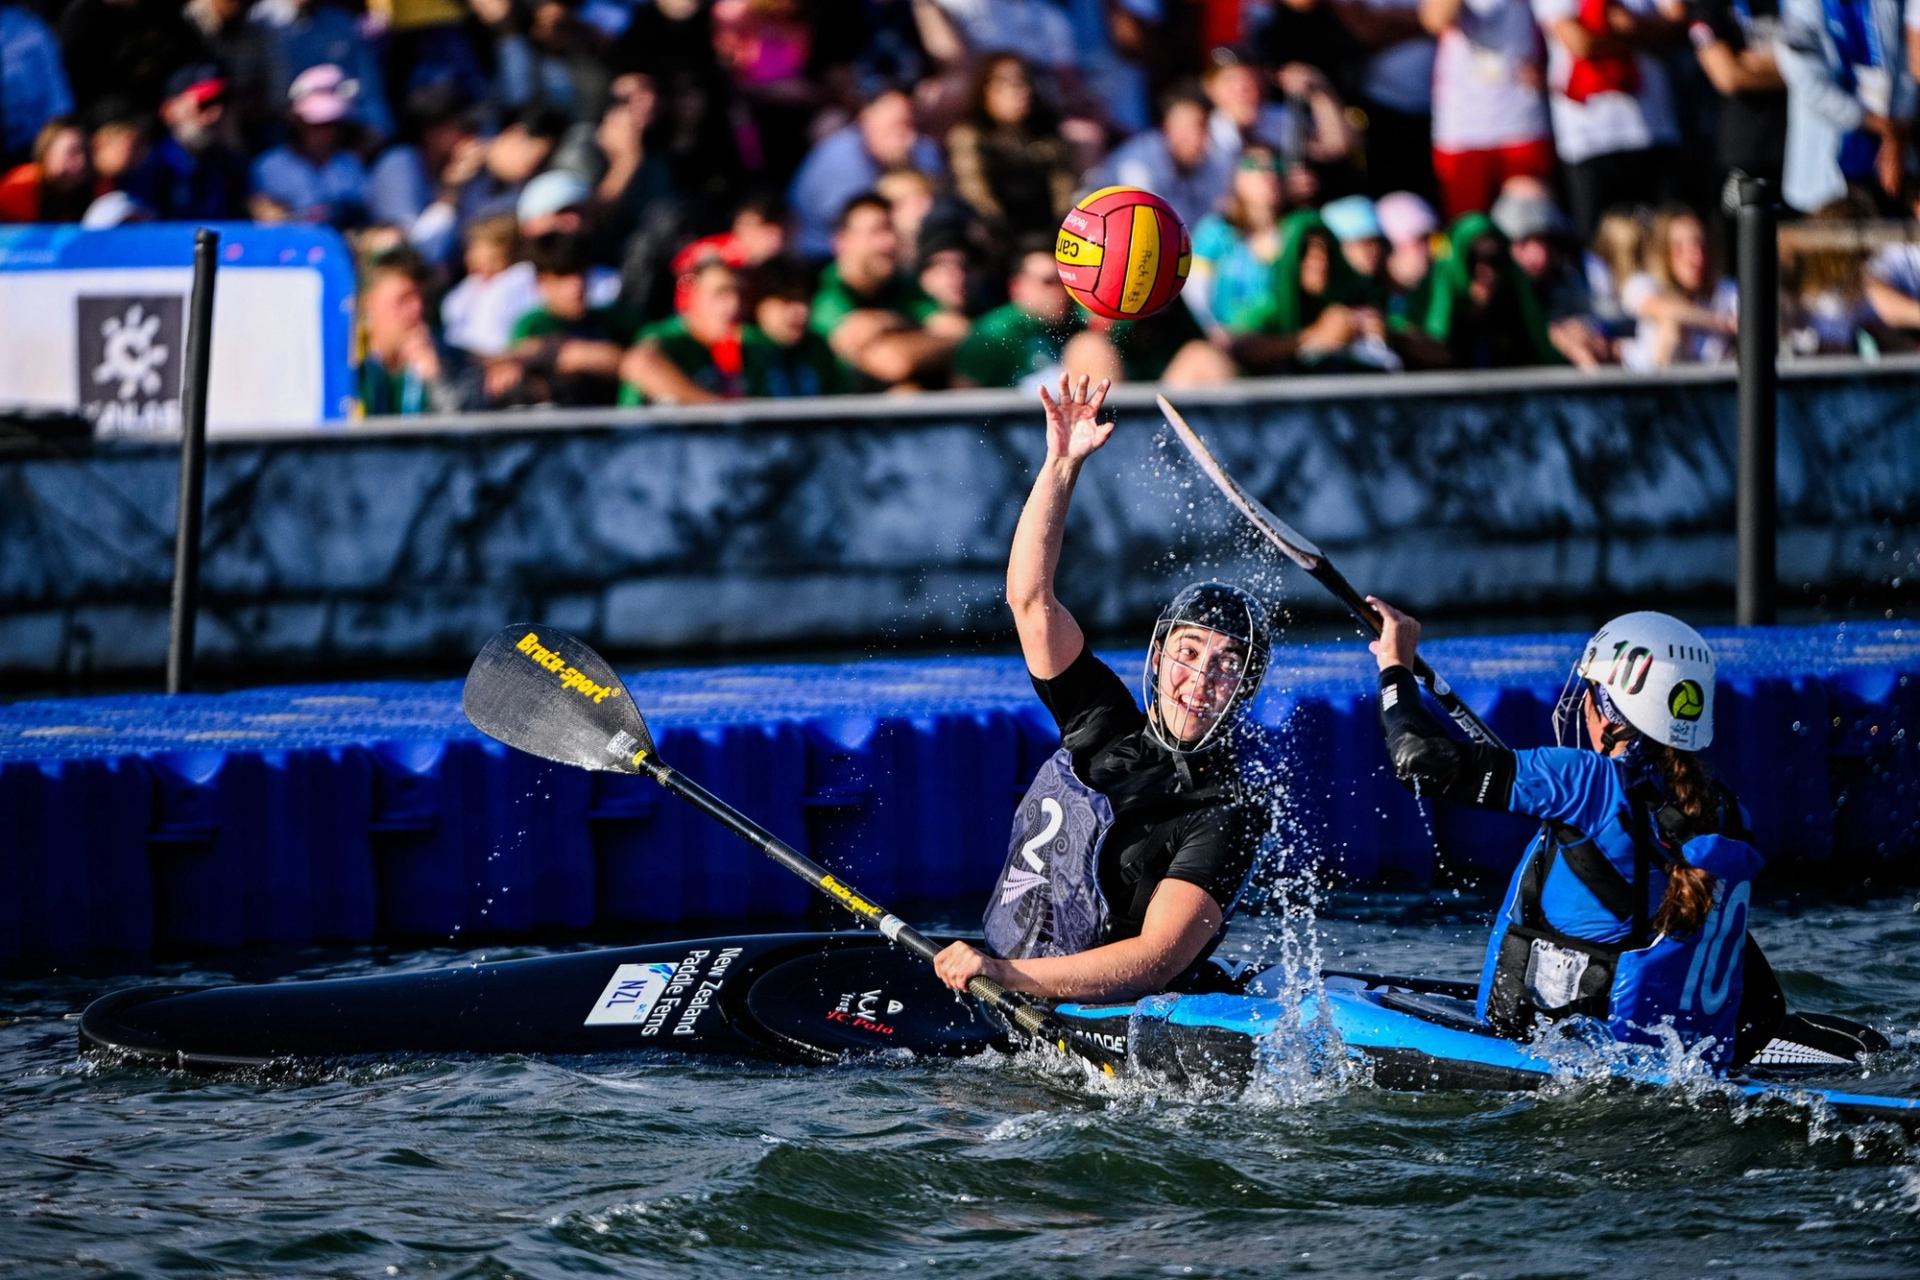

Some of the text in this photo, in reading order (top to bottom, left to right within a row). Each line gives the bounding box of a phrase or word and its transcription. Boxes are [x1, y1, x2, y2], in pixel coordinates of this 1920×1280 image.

[1608, 640, 1654, 695] 10
[1022, 798, 1063, 873] 2
[1680, 879, 1751, 1015] 10
[606, 980, 648, 1008] NZL
[641, 950, 710, 1036] Paddle Ferns
[672, 948, 743, 1036] New Zealand
